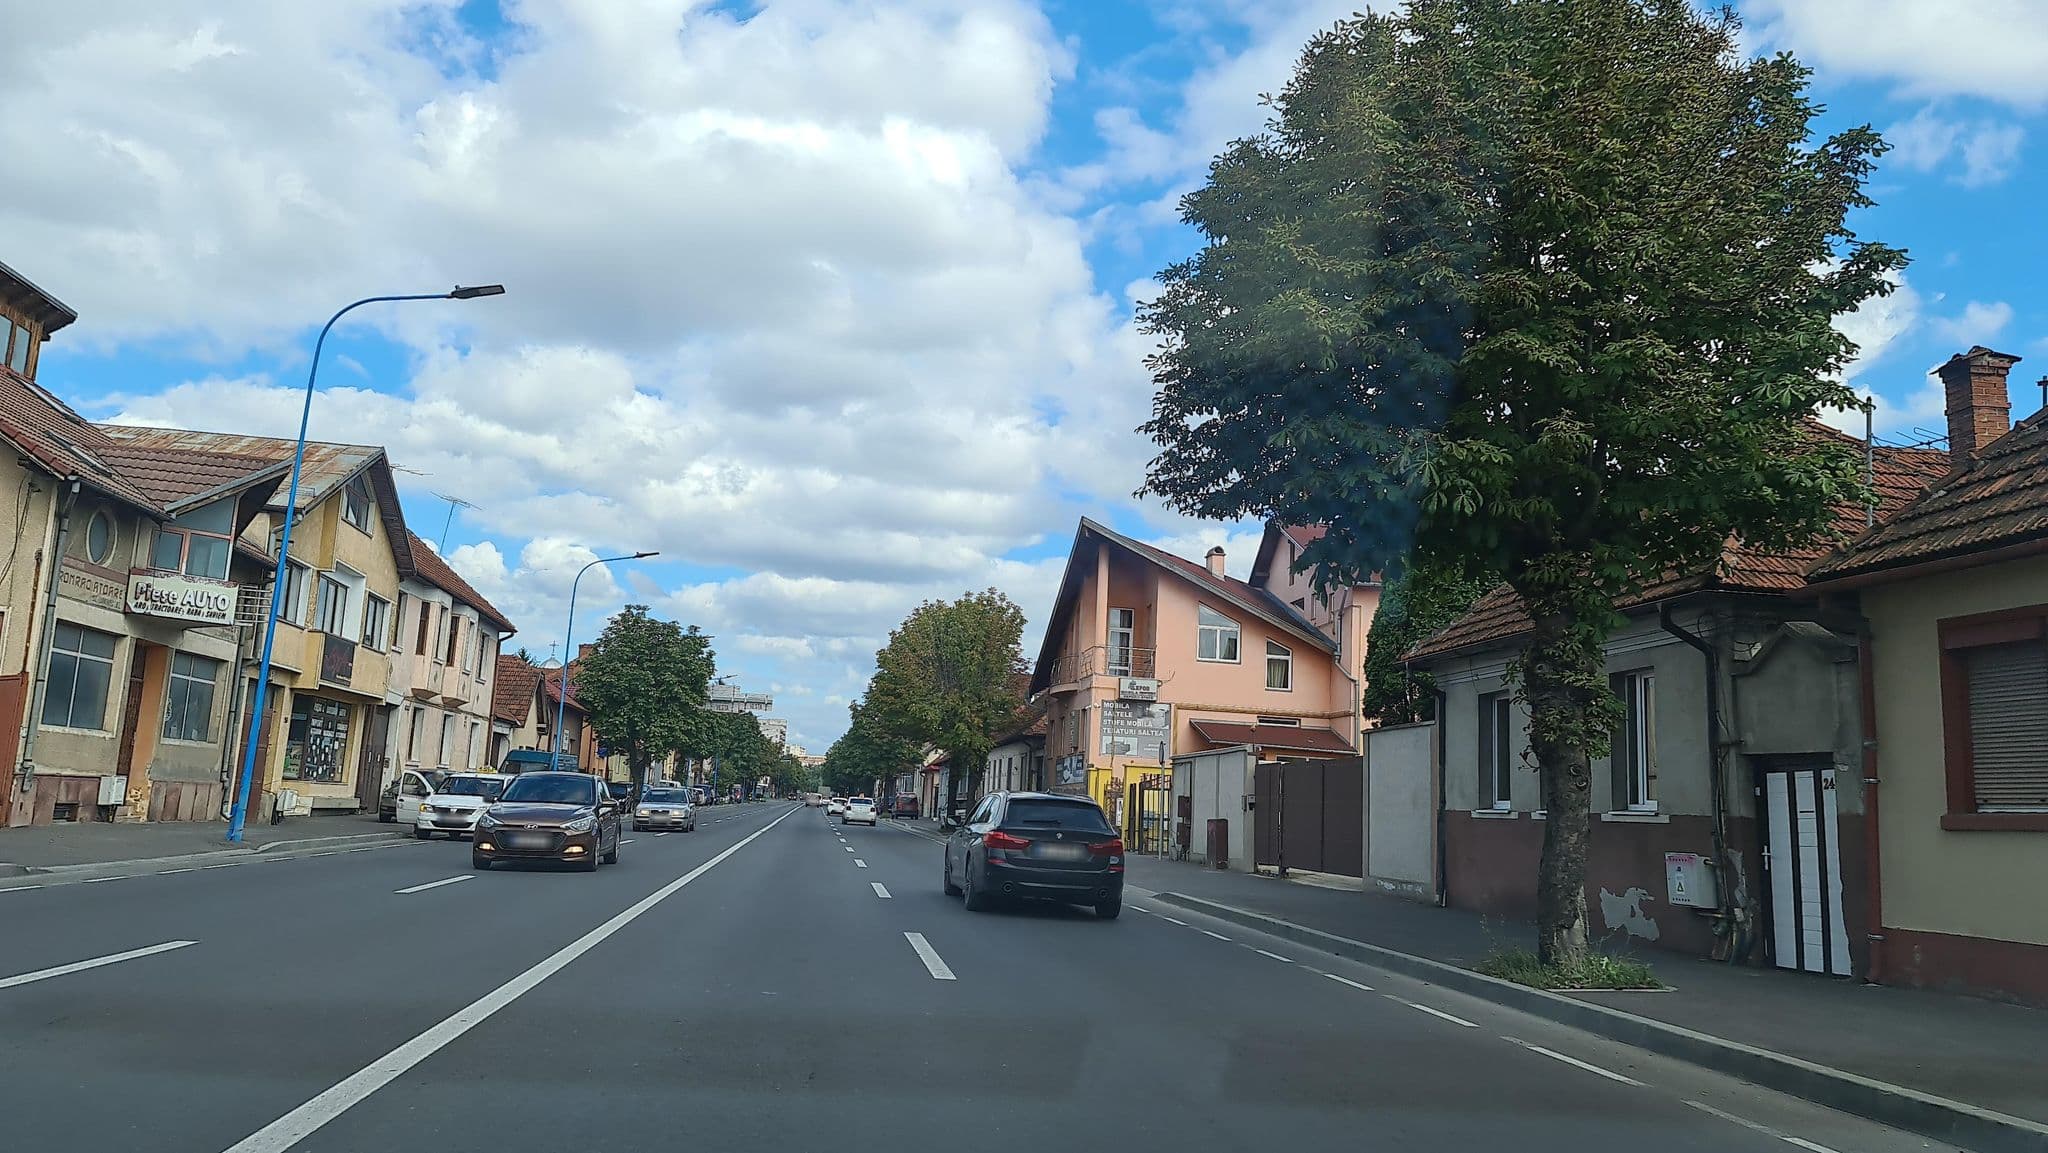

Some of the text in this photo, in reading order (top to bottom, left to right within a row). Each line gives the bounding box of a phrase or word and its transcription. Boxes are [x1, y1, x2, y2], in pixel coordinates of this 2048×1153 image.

[135, 581, 178, 605] Piese
[181, 589, 230, 611] AUTO
[1823, 777, 1835, 790] 24
